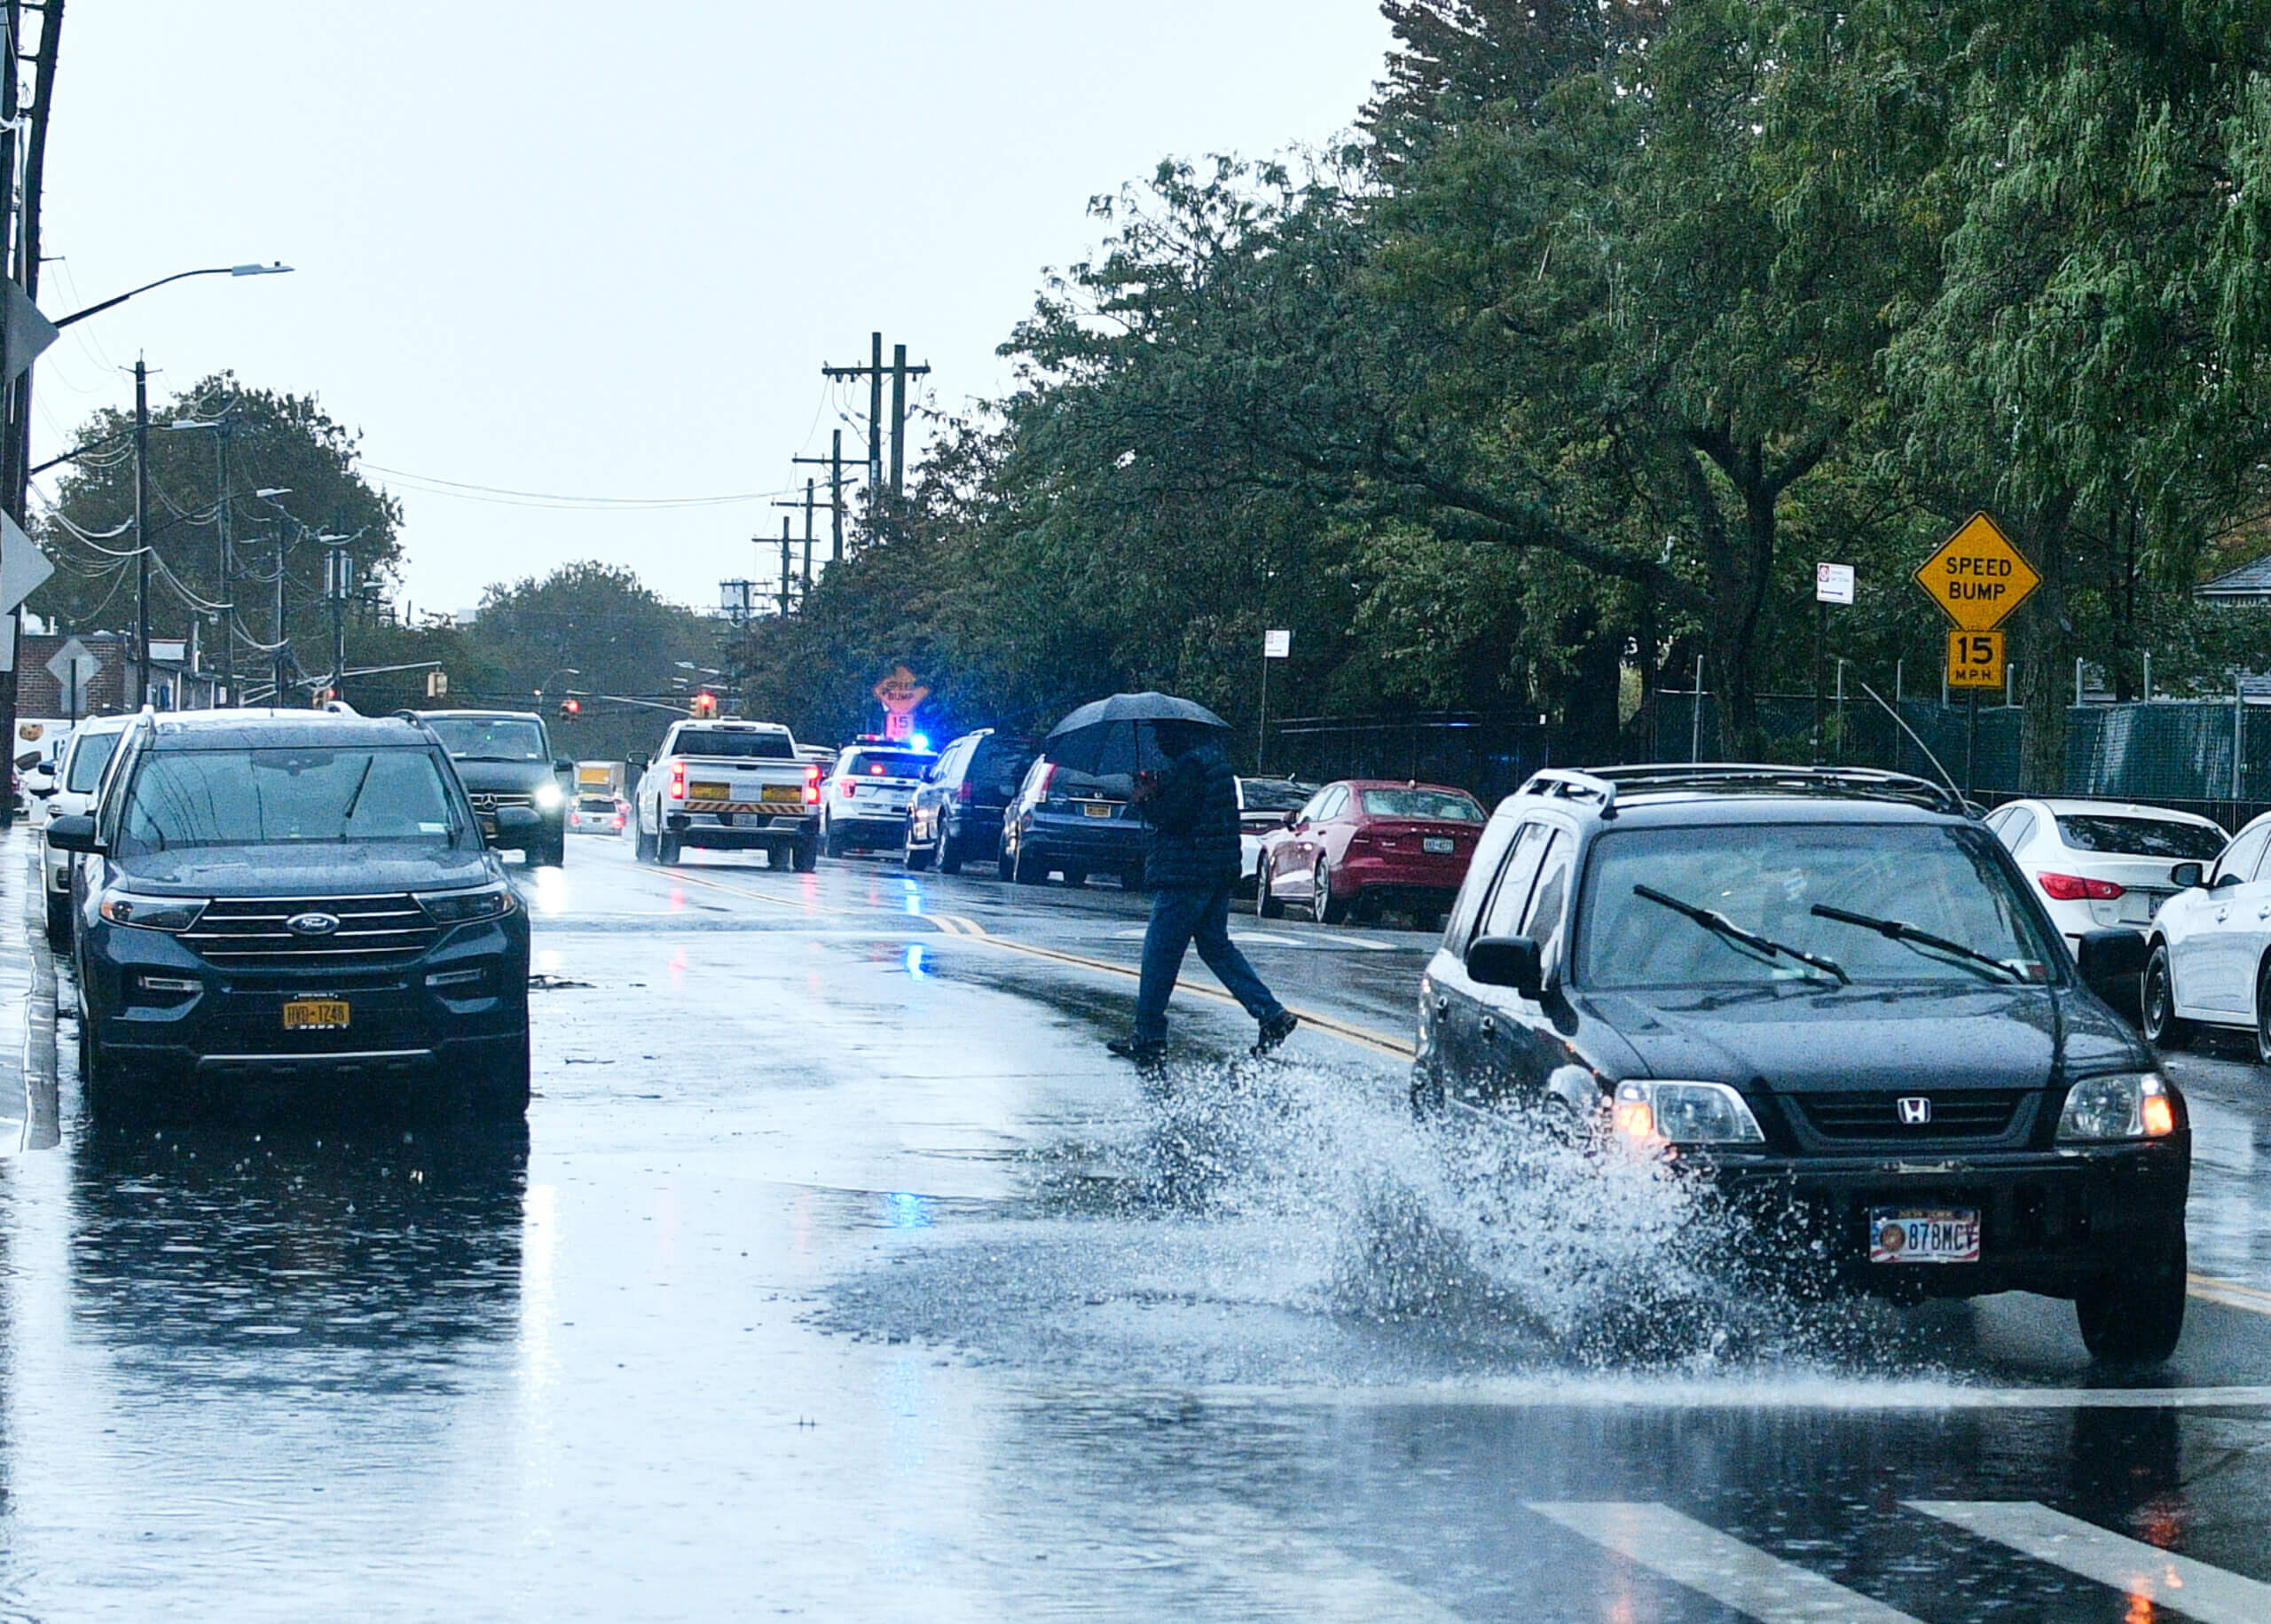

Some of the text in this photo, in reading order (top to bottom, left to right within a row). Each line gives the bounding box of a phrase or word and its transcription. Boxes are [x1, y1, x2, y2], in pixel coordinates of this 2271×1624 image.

[1945, 557, 2012, 577] SPEED
[1949, 582, 2006, 600] BUMP
[1958, 636, 1993, 664] 15
[893, 716, 908, 728] 15
